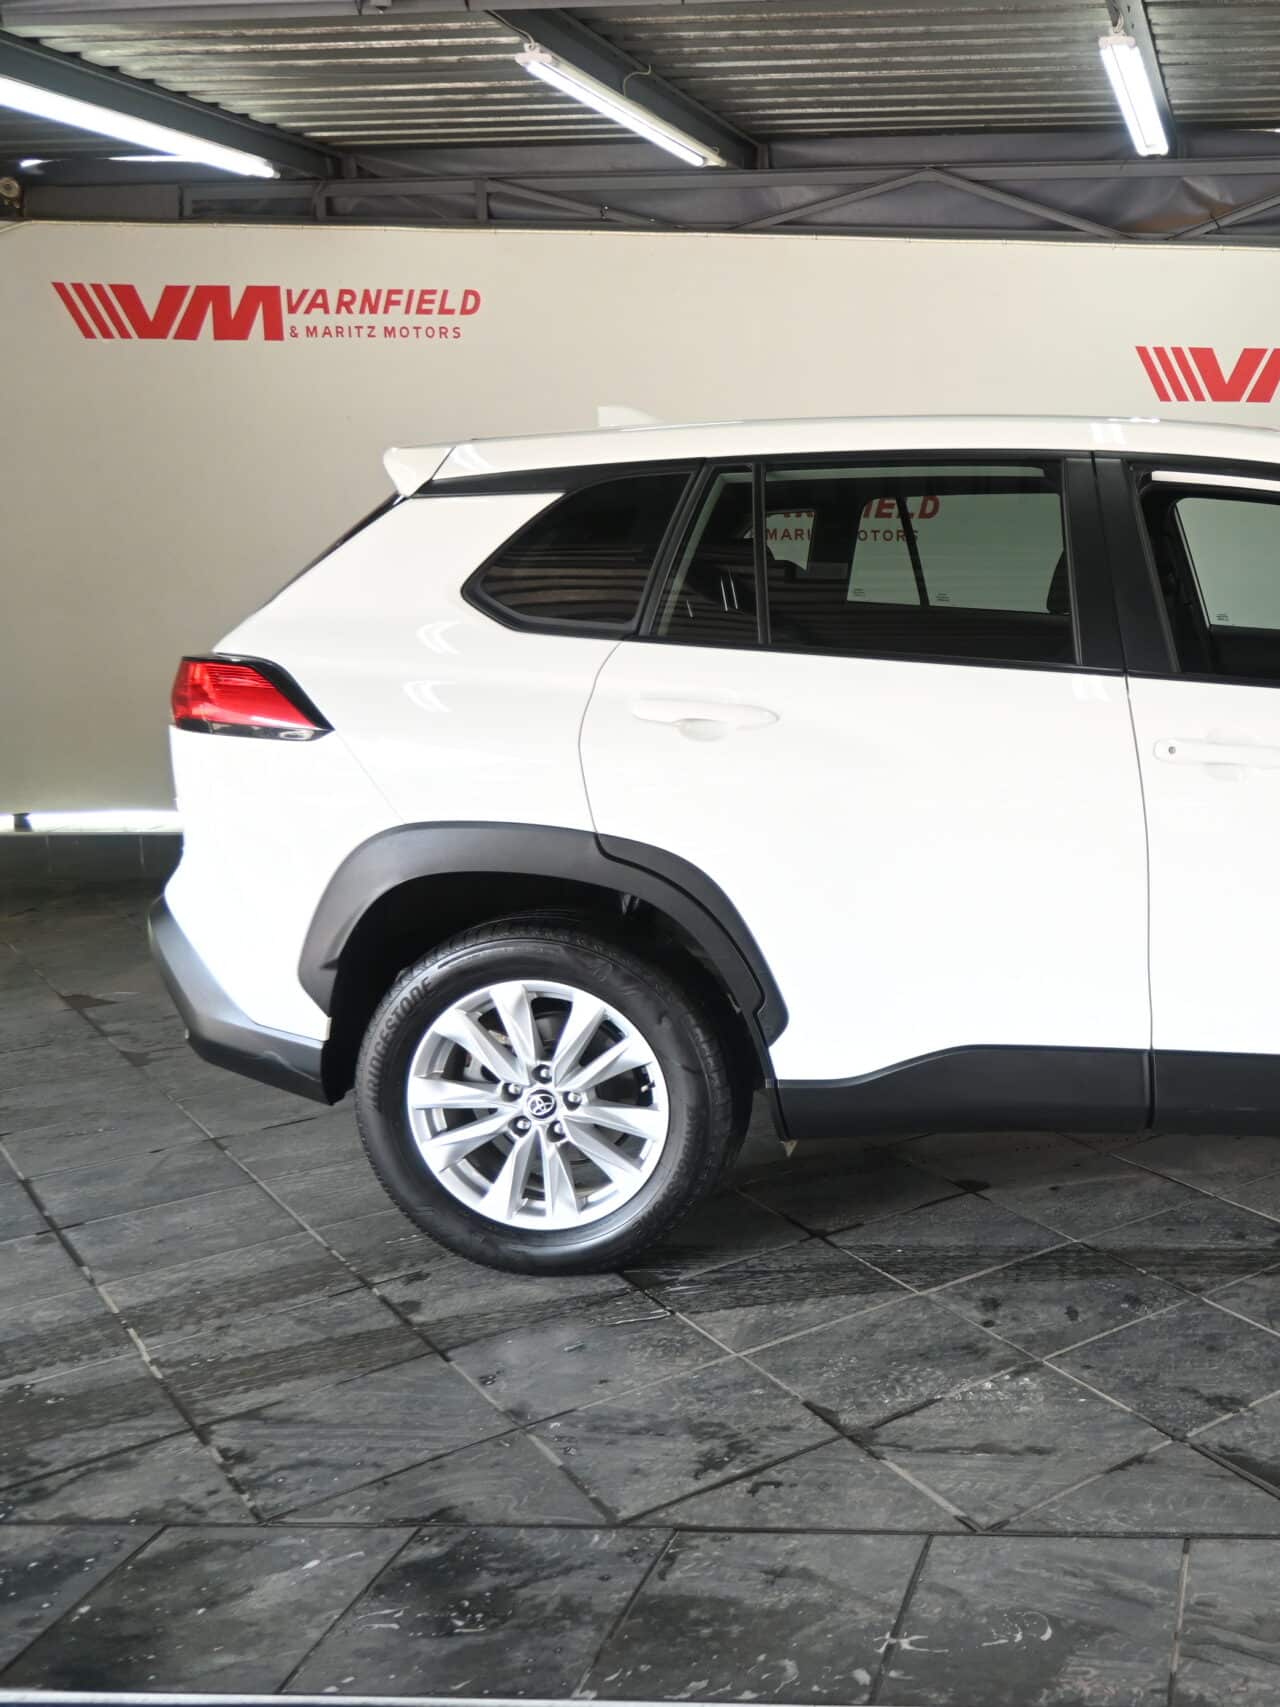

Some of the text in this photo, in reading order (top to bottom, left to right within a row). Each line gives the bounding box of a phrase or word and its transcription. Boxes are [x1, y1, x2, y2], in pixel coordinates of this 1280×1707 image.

[108, 283, 285, 342] VM
[286, 288, 482, 317] VARNFIELD
[289, 325, 462, 340] & MARITZ MOTORS
